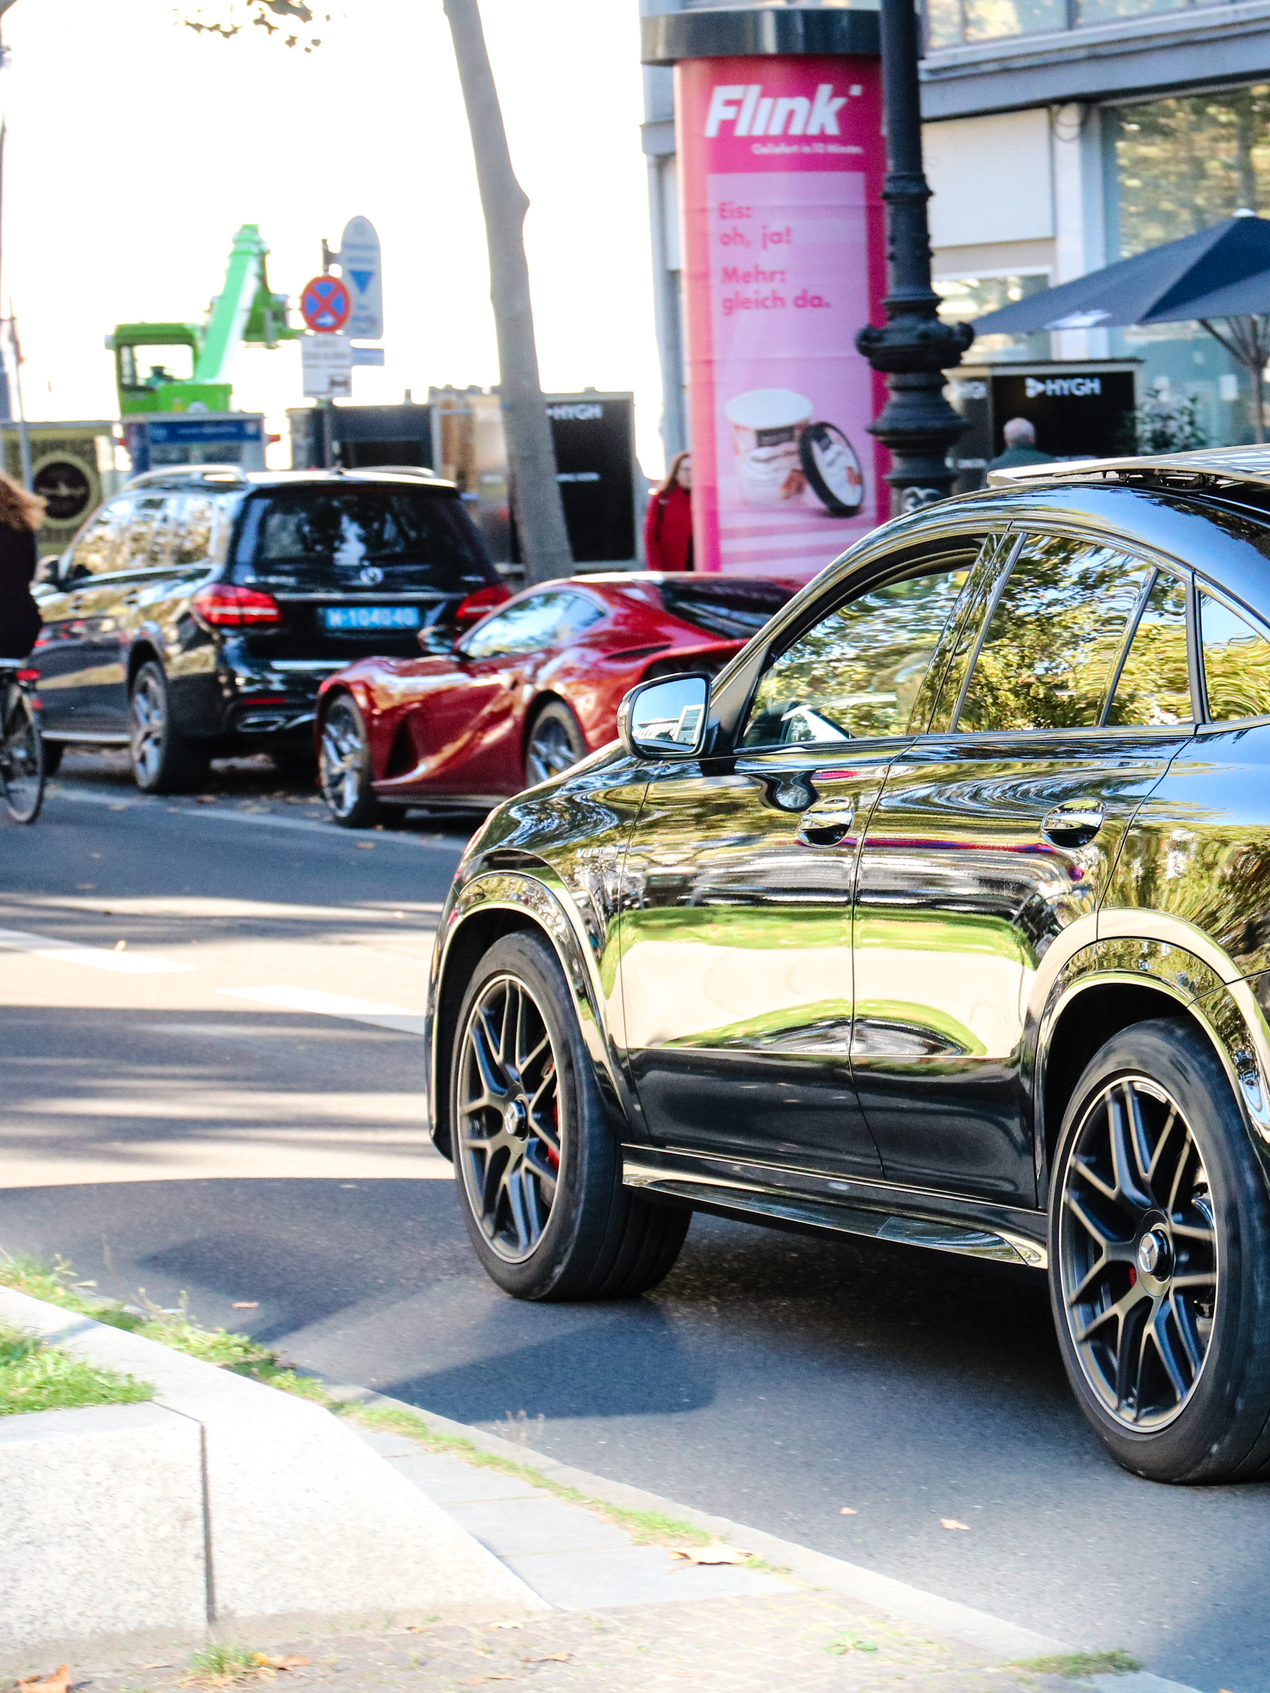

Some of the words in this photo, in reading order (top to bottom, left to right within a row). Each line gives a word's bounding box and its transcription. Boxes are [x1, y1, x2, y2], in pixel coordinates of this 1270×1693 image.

[704, 83, 862, 138] Flink
[718, 200, 753, 220] Eis:
[719, 225, 752, 248] oh,
[761, 224, 792, 251] ja!
[721, 262, 787, 284] Mehr:
[721, 289, 787, 317] gleich
[793, 288, 832, 309] da.
[1046, 377, 1102, 397] HYGH
